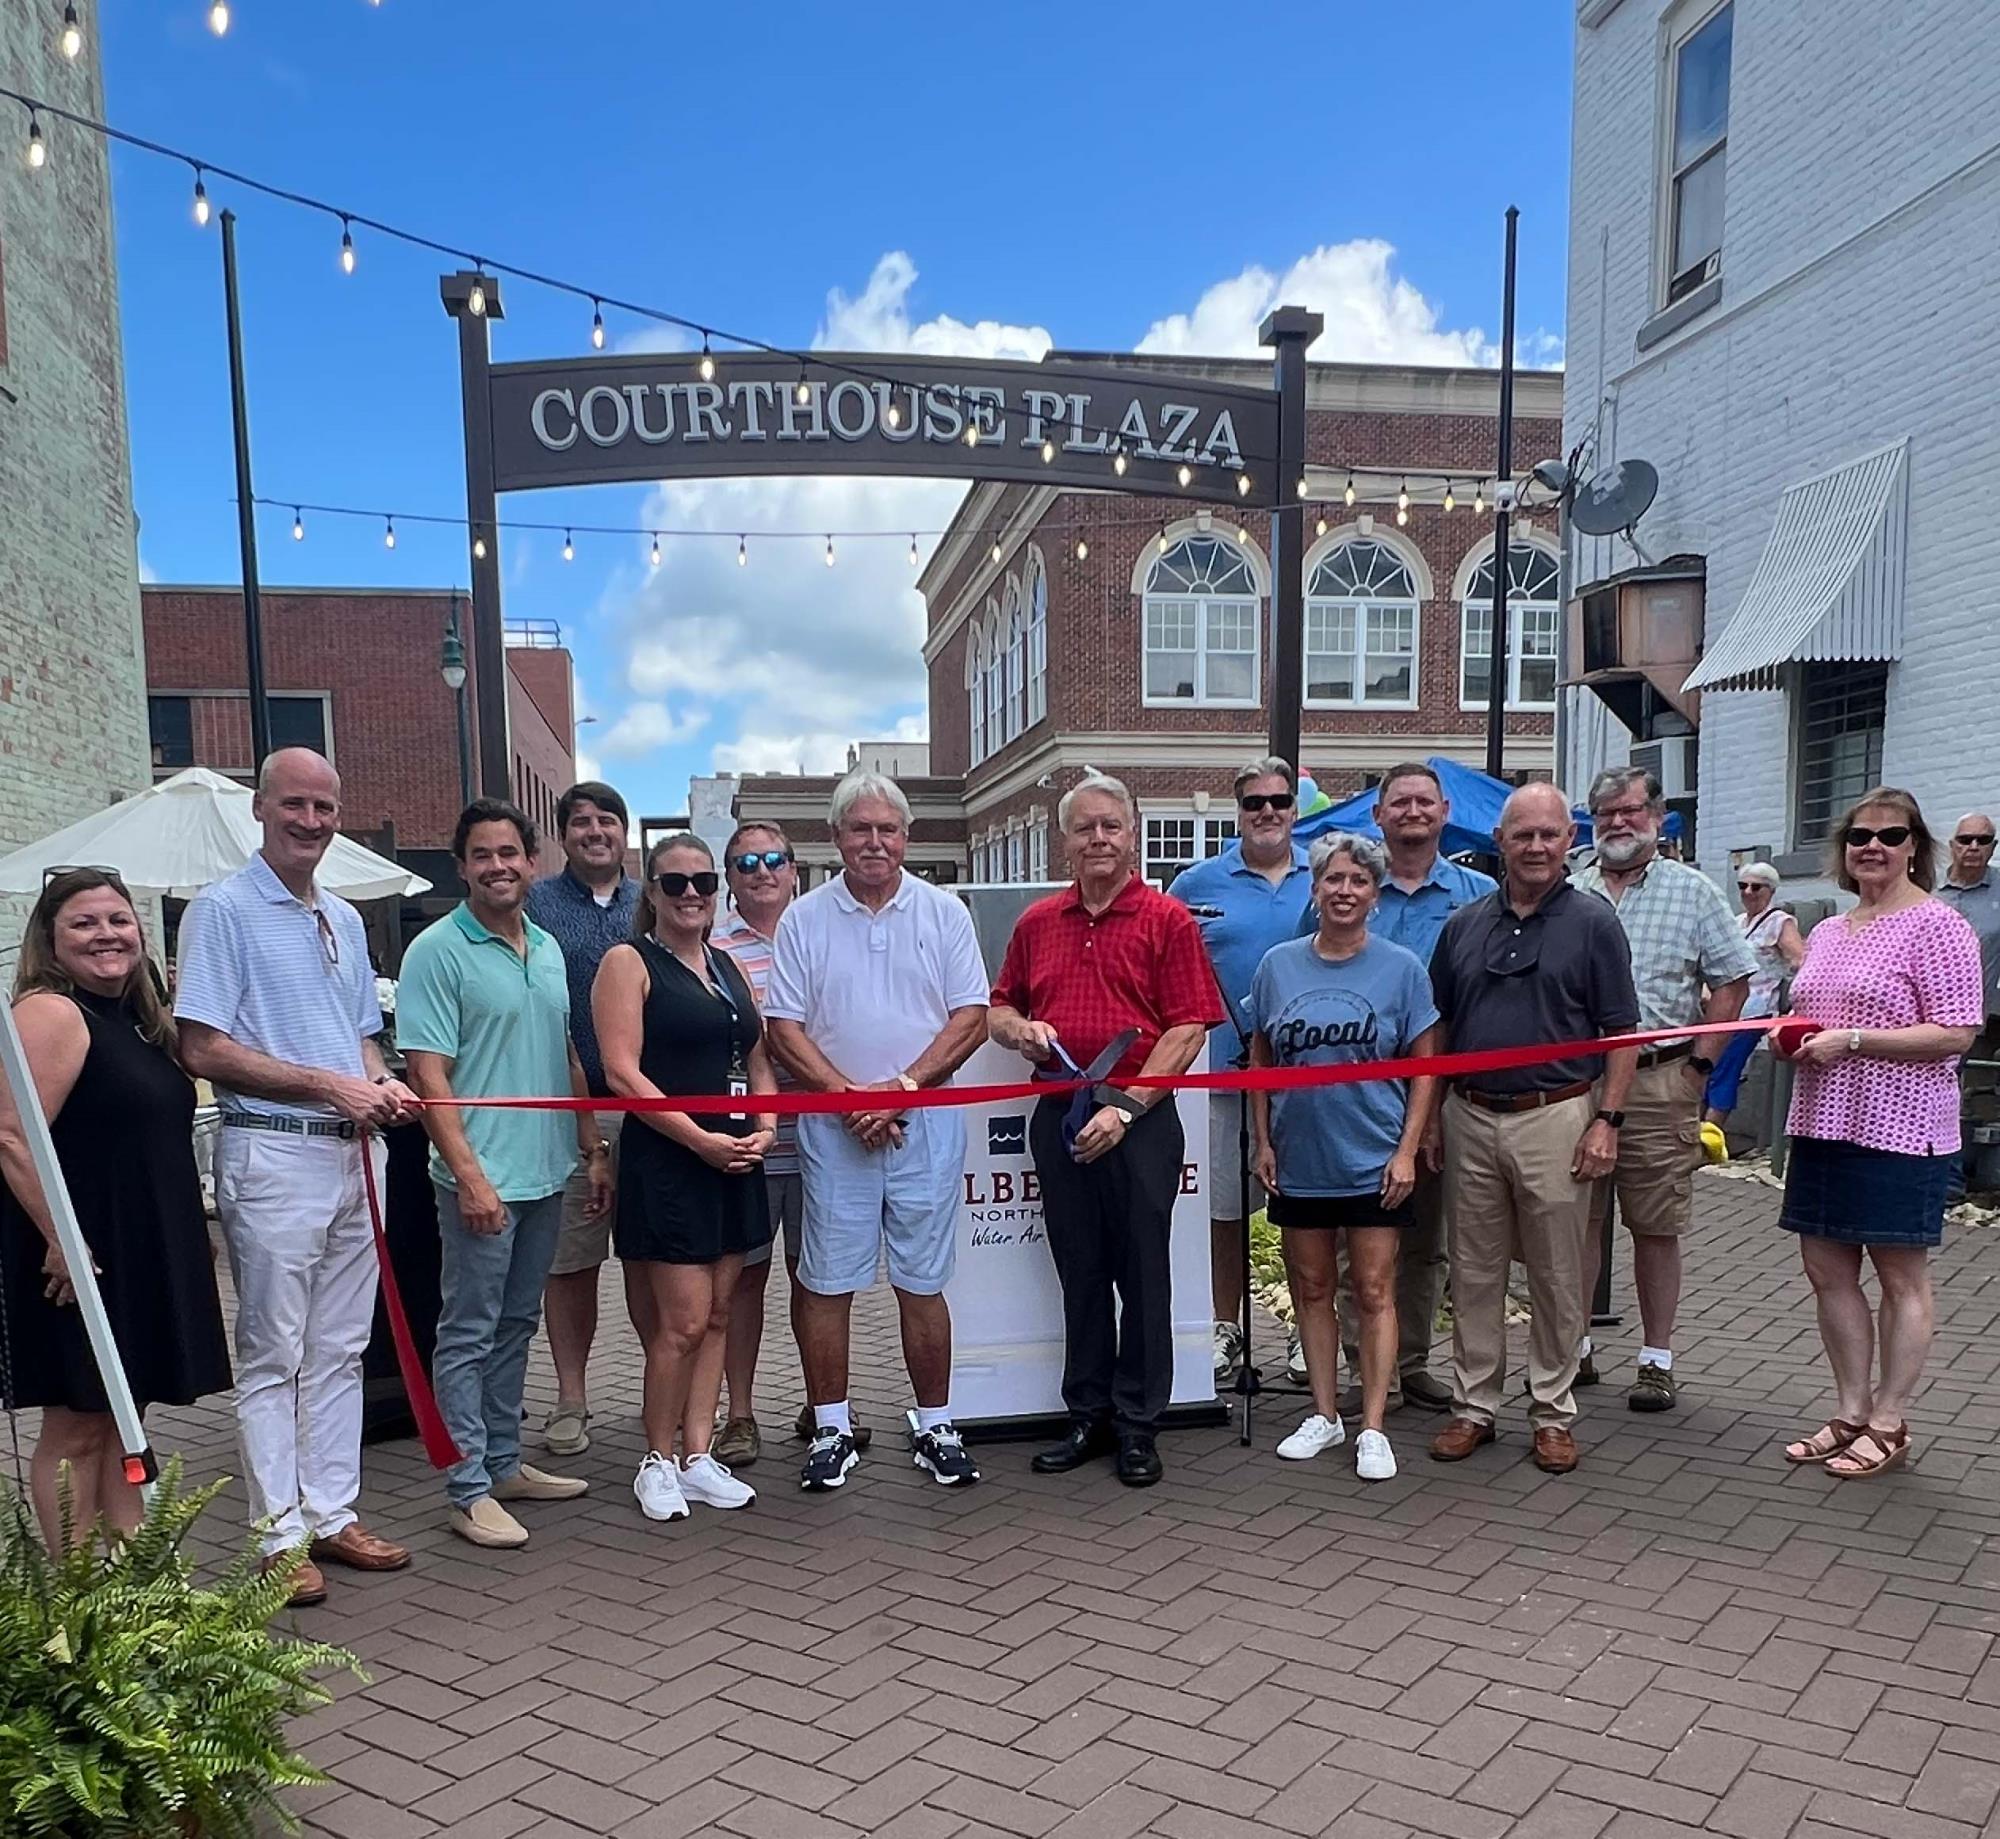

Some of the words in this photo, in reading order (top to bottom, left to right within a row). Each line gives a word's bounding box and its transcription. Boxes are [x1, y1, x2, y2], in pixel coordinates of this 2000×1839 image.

[531, 380, 1006, 451] COURTHOUSE
[1020, 389, 1247, 470] PLAZA
[1278, 1012, 1378, 1057] Local
[971, 1208, 1044, 1222] NORTH
